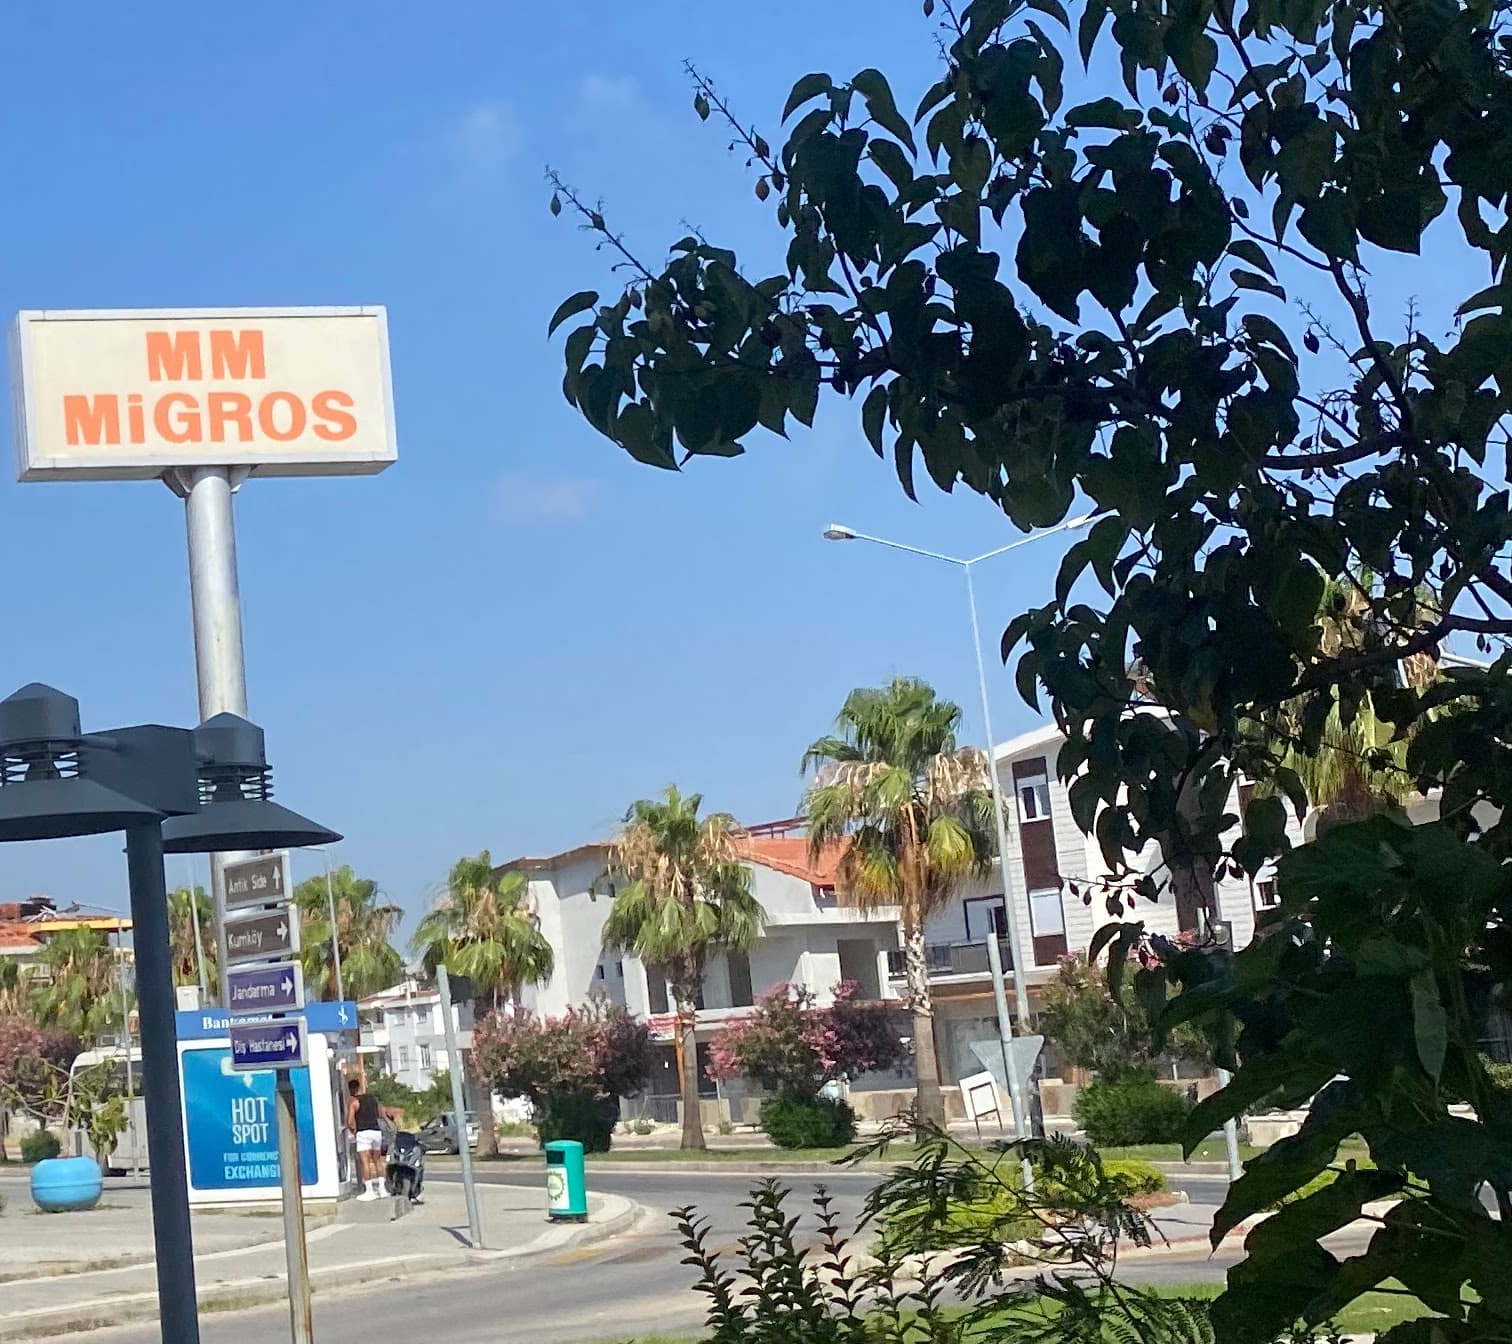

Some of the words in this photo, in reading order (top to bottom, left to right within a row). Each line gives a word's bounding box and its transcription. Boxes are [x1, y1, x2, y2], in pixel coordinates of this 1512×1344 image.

[146, 330, 266, 382] MM
[251, 874, 267, 890] Side
[227, 929, 263, 950] Kumköy
[232, 985, 276, 1001] Jandarma
[231, 1097, 268, 1124] HOT
[232, 1123, 269, 1145] SPOT
